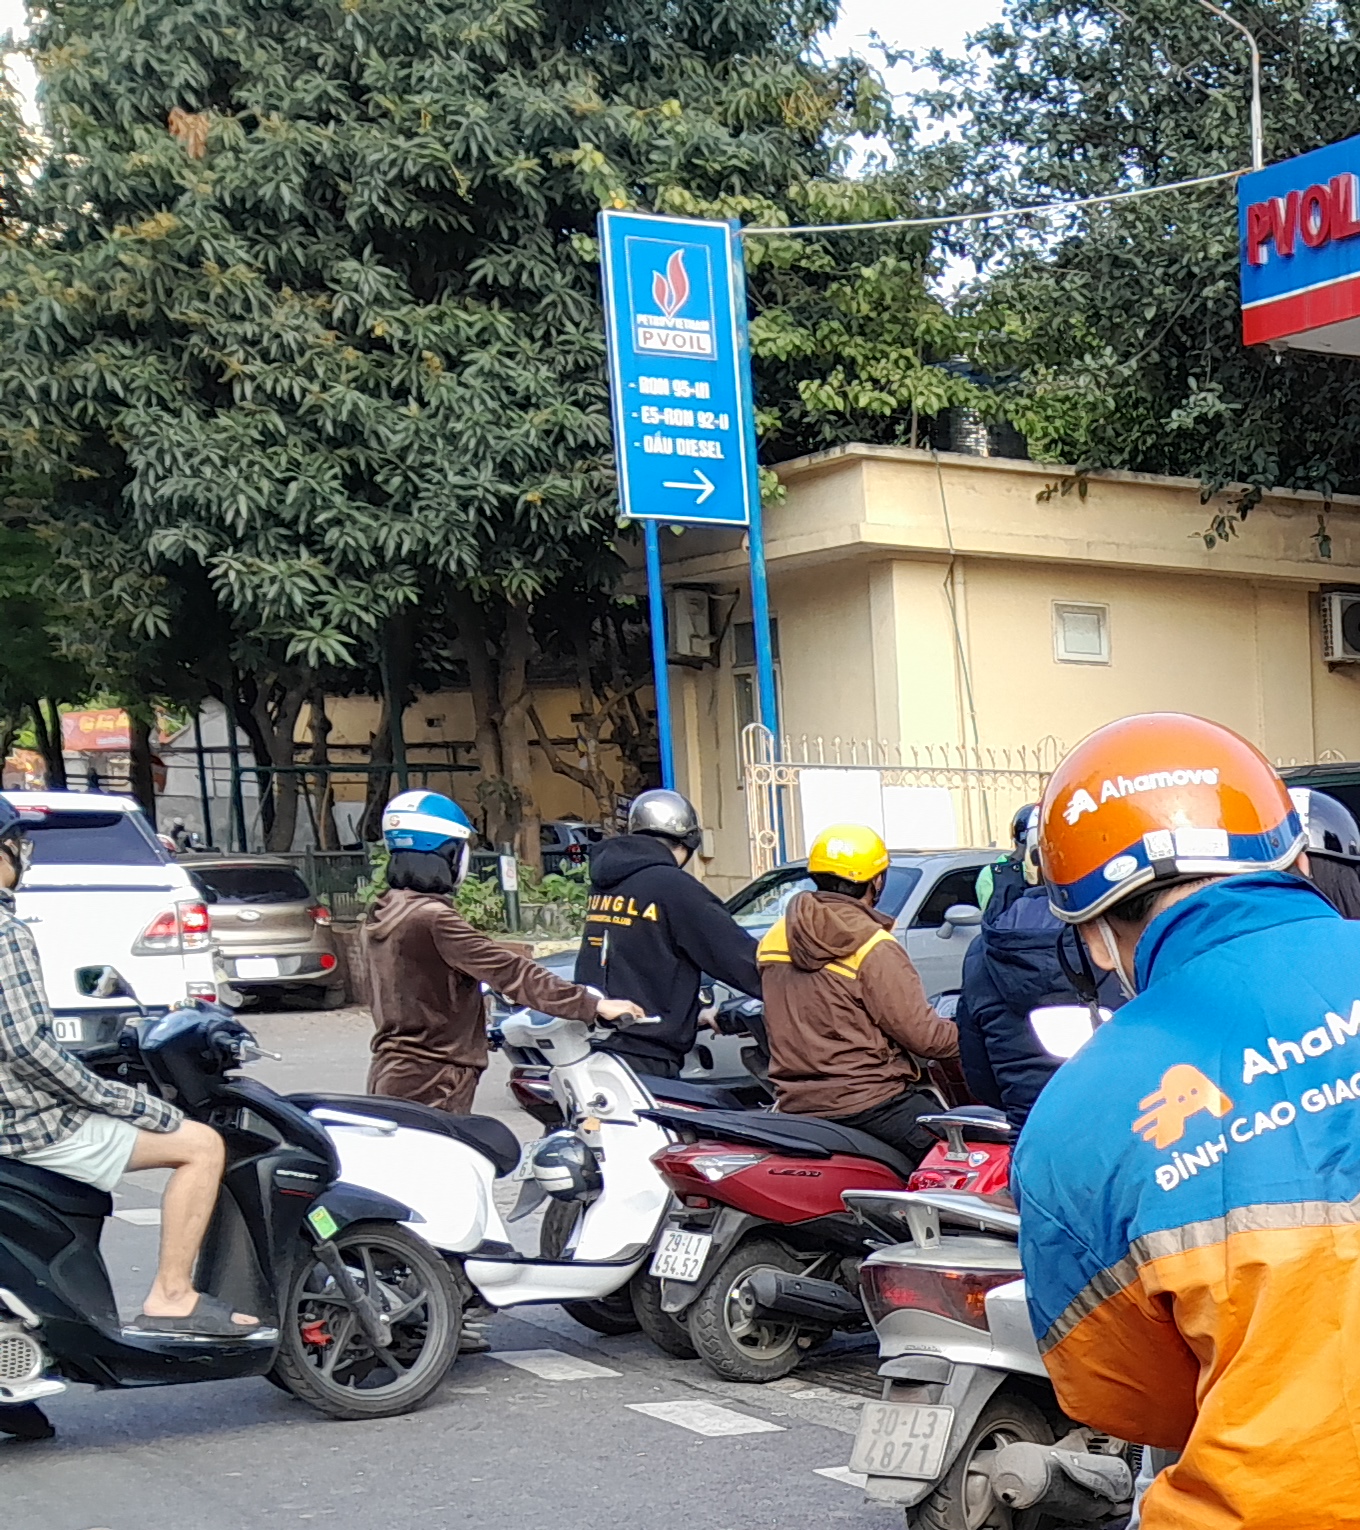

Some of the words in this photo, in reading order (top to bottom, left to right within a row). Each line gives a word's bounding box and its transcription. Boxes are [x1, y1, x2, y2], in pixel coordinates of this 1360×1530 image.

[643, 330, 707, 351] PVOIL
[676, 438, 725, 460] DIESEL
[1100, 767, 1218, 804] Ahamove
[1230, 1101, 1296, 1143] CAO
[871, 1407, 938, 1440] 30-L3
[864, 1439, 930, 1472] 4871
